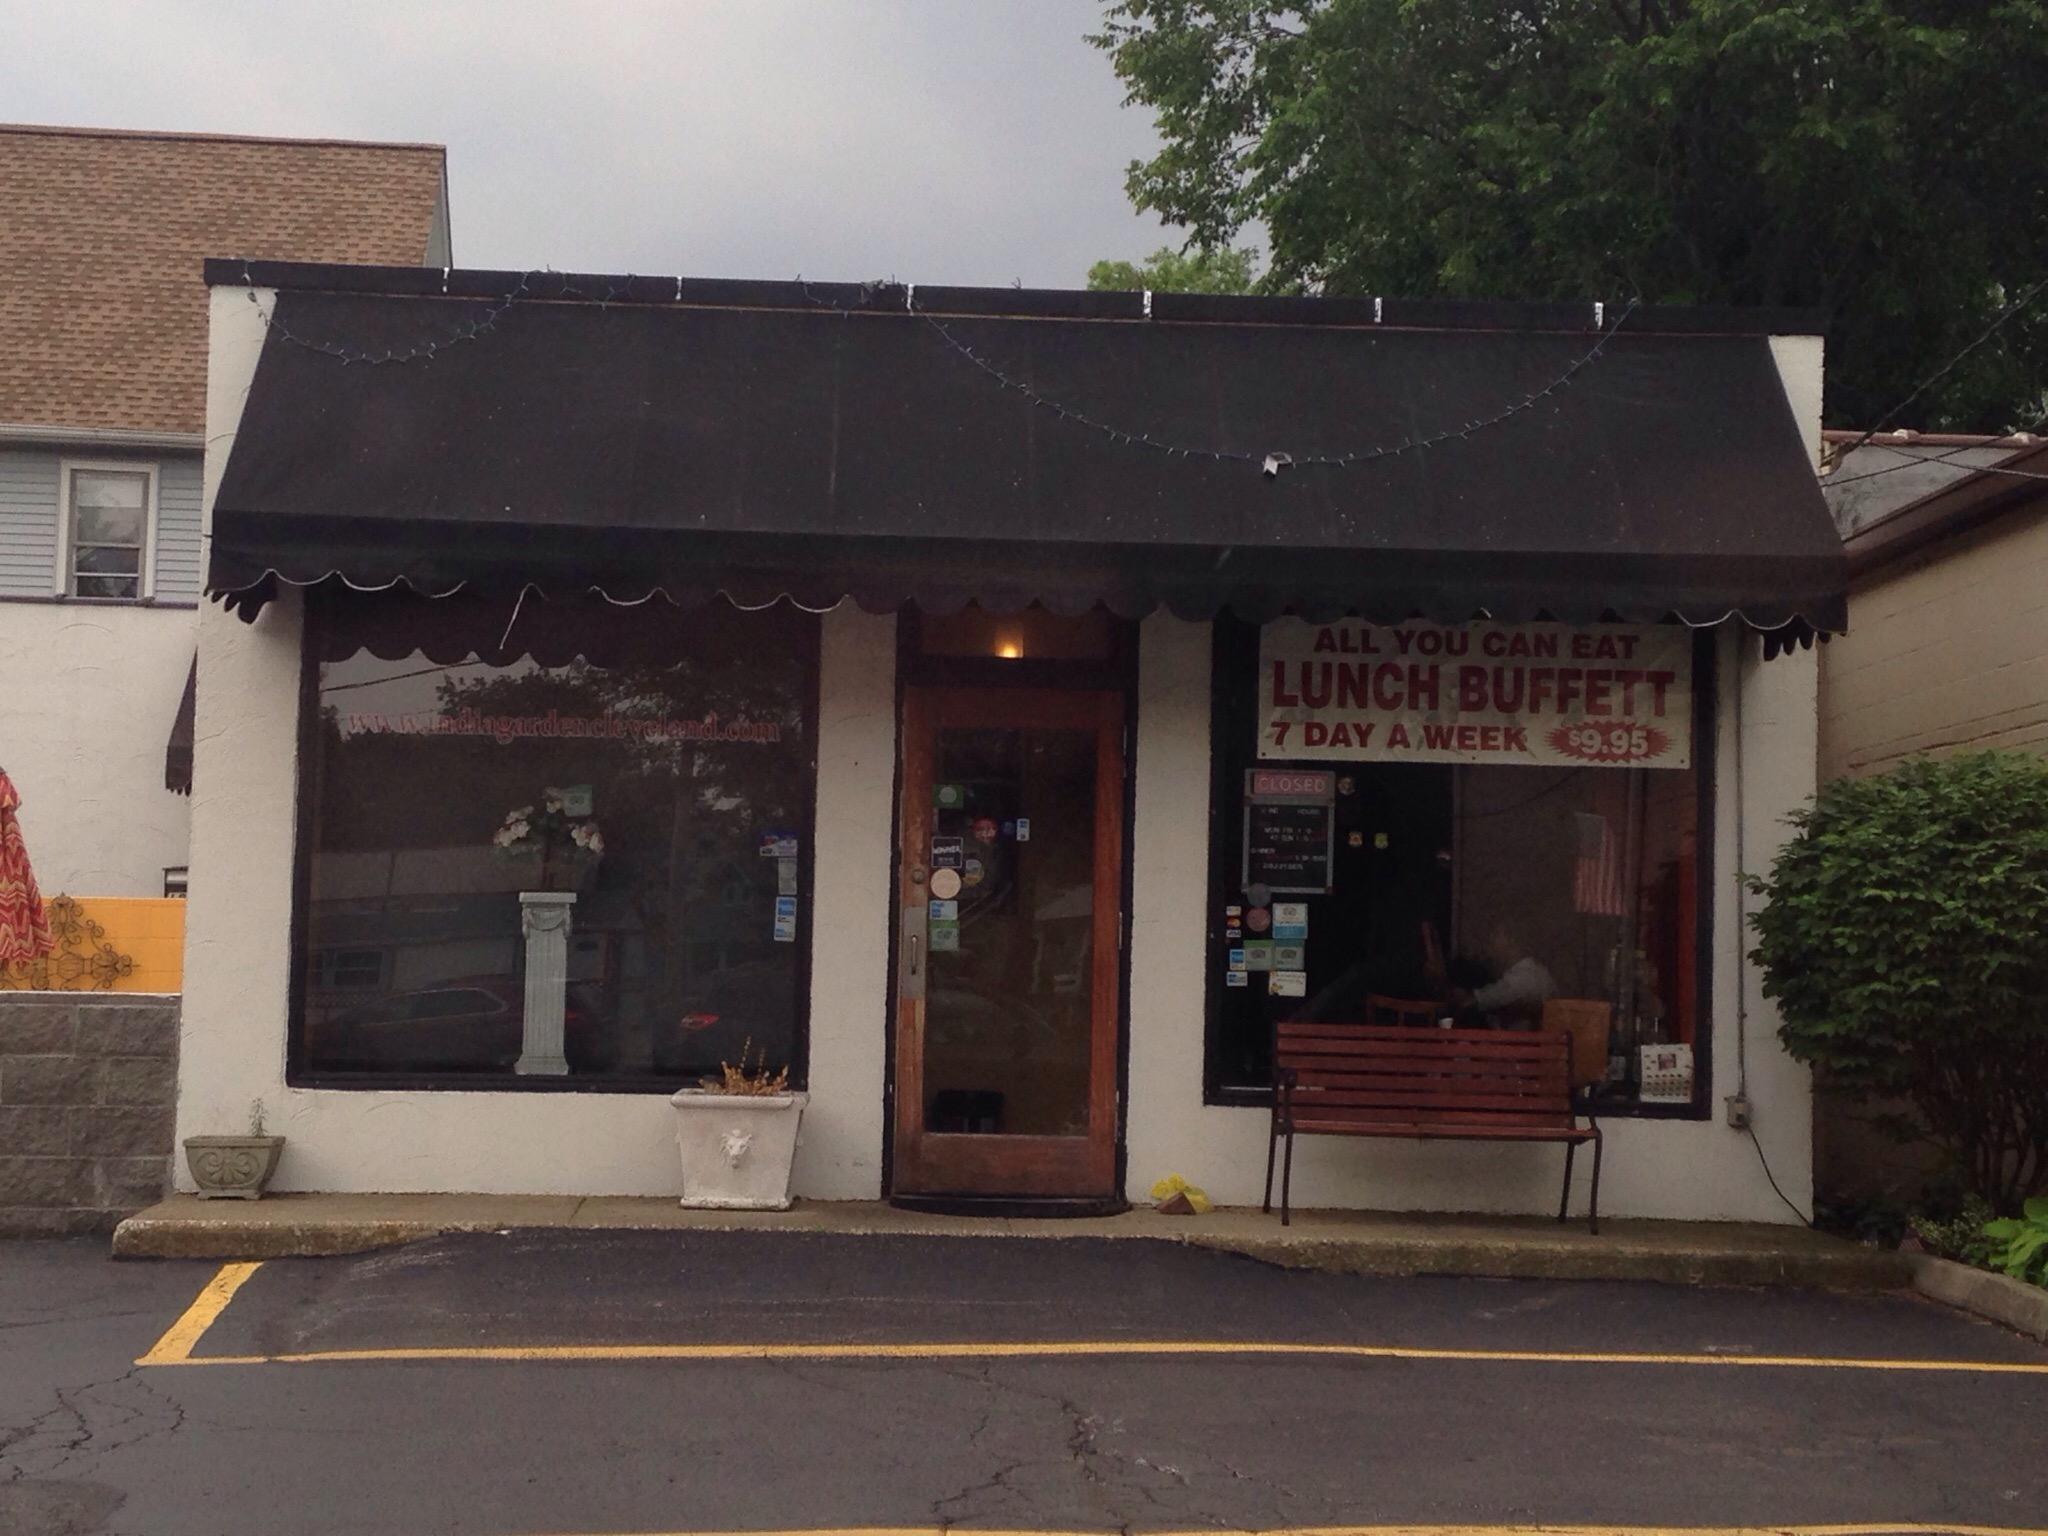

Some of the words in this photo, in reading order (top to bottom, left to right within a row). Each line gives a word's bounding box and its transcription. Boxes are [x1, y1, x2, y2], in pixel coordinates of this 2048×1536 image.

[1313, 627, 1381, 654] ALL
[1394, 629, 1470, 657] YOU
[1482, 631, 1559, 659] CAN
[1571, 633, 1641, 660] EAT
[1272, 659, 1440, 711] LUNCH
[1458, 664, 1676, 717] BUFFETT
[1270, 721, 1289, 747] 7
[1304, 722, 1376, 748] DAY
[1387, 723, 1412, 749] A
[1424, 724, 1529, 752] WEEK
[1568, 728, 1649, 756] $9.95
[1258, 777, 1327, 793] CLOSED
